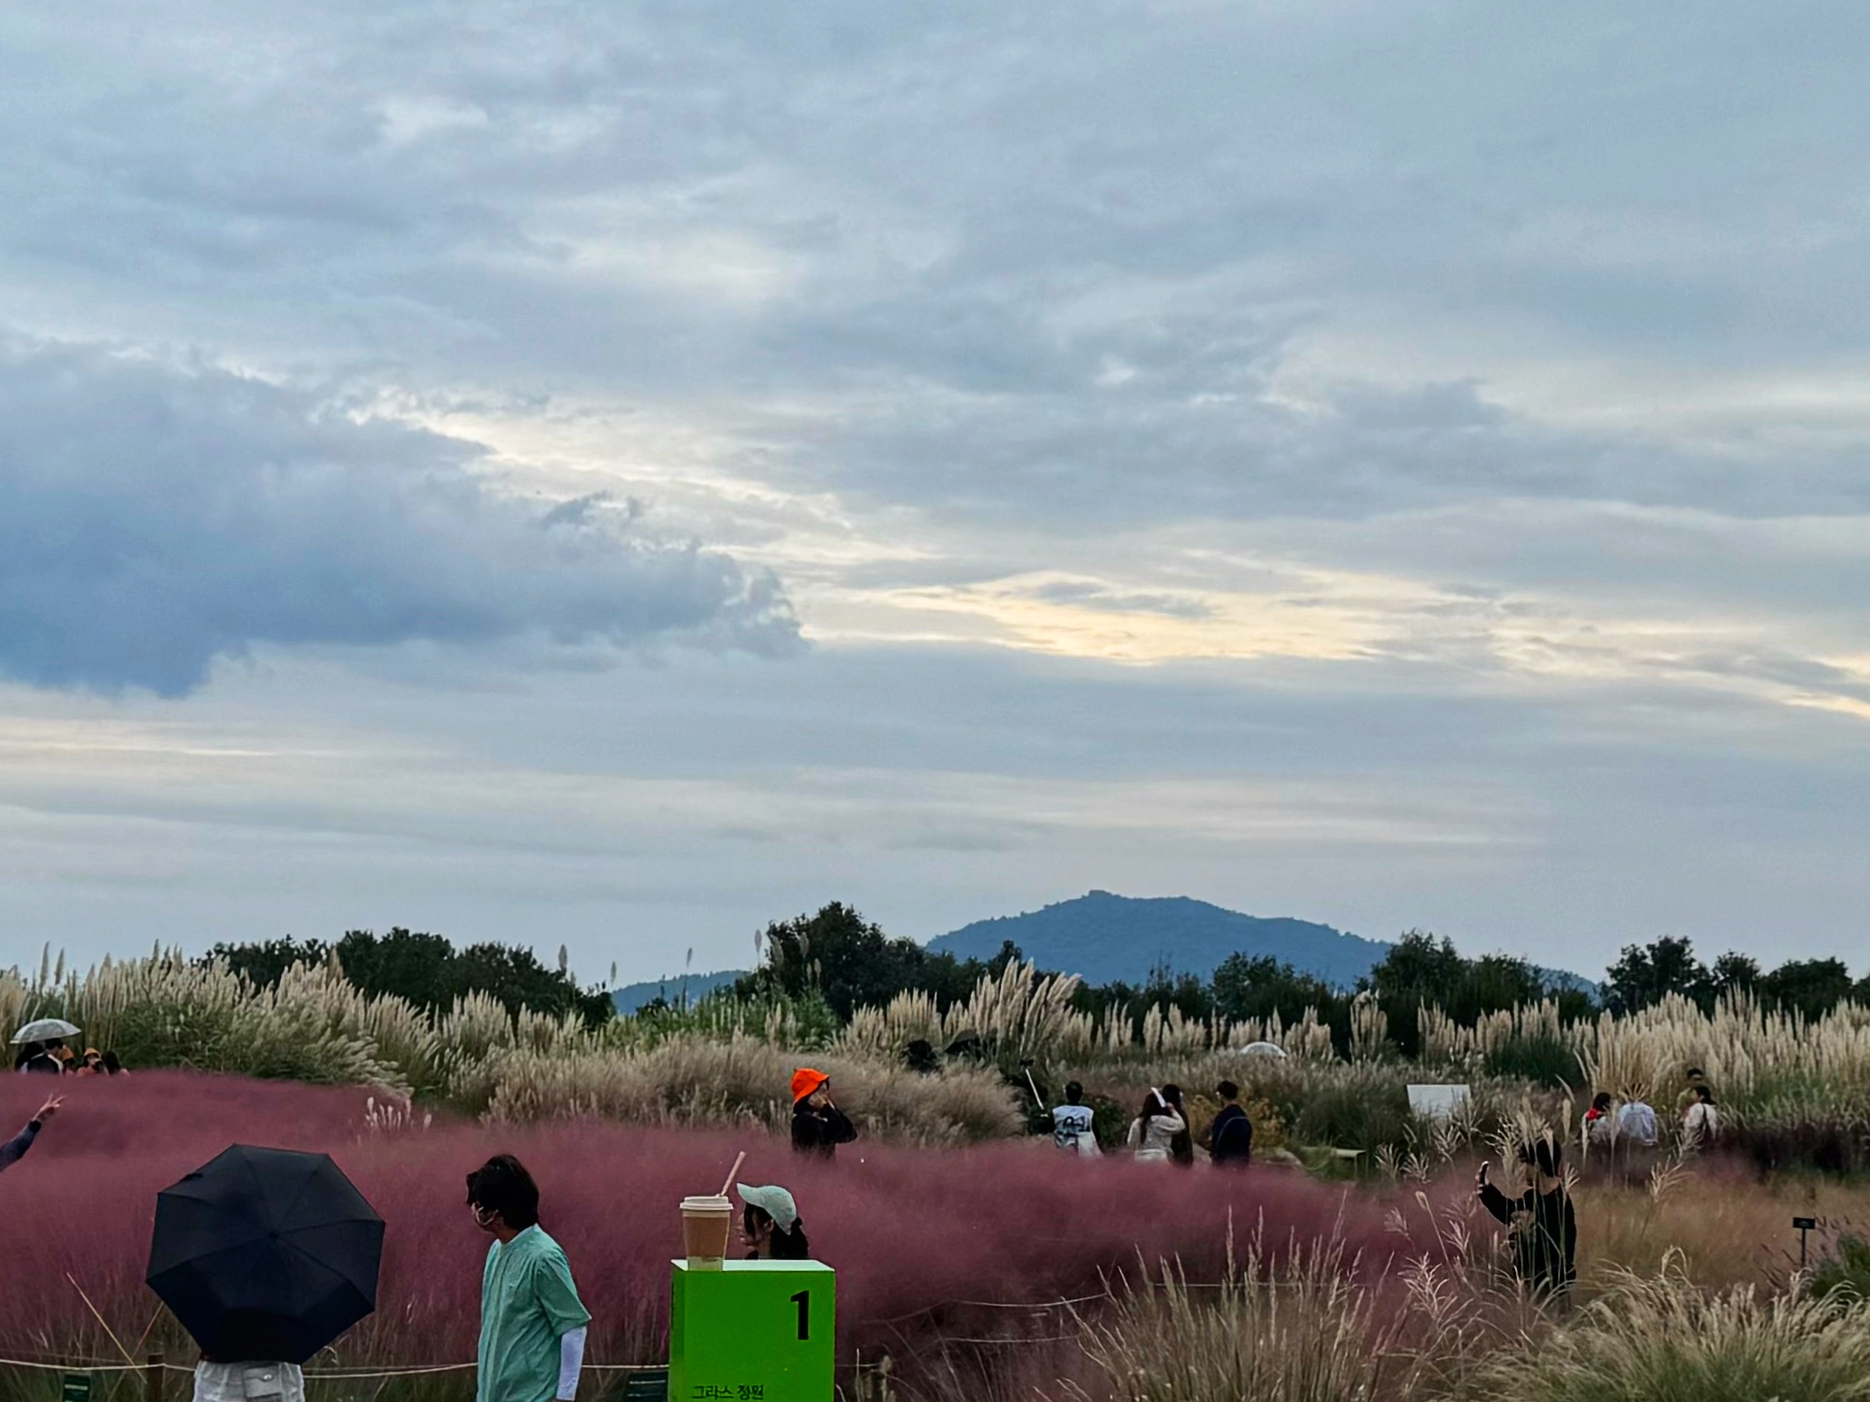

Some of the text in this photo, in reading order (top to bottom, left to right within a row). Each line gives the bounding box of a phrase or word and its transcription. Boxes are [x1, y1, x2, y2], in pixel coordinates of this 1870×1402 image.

[790, 1289, 810, 1341] 1
[692, 1384, 764, 1401] 그라스 정원
